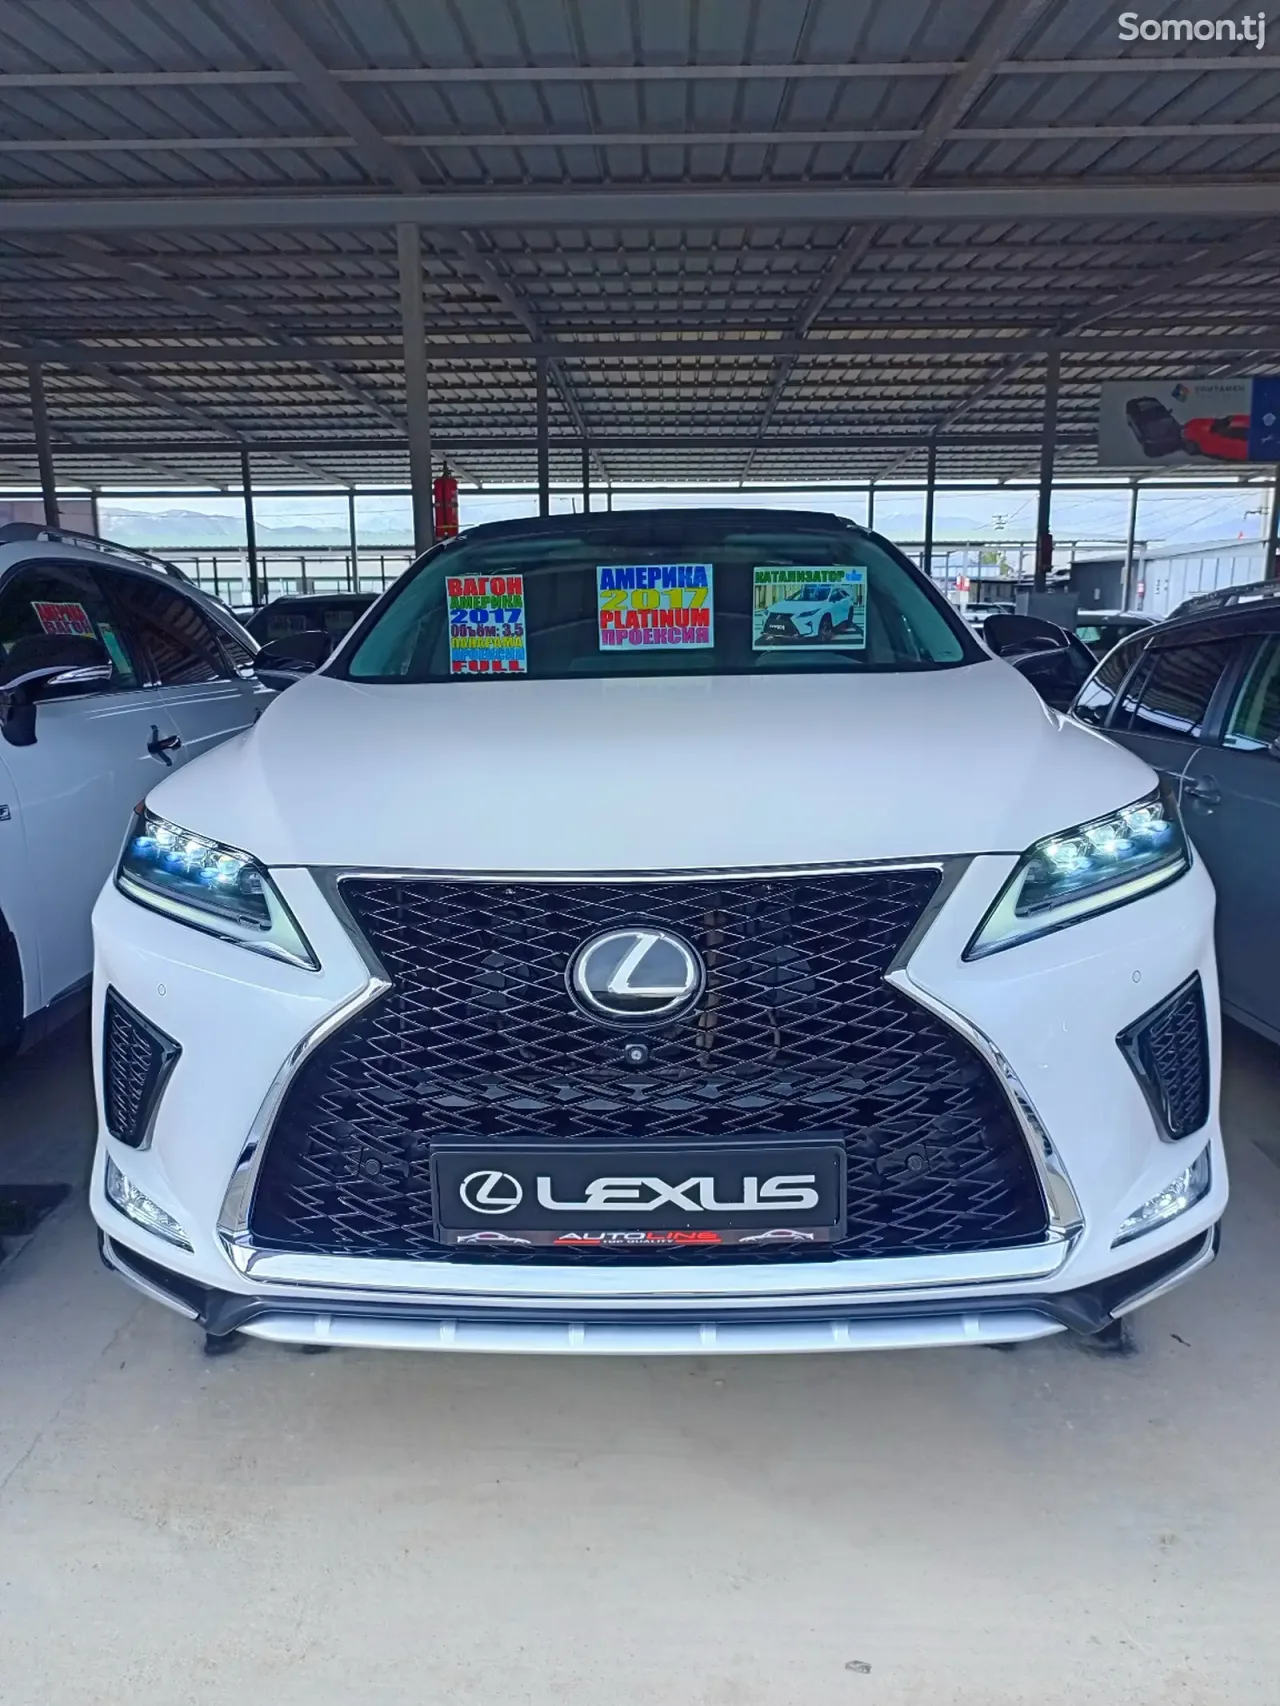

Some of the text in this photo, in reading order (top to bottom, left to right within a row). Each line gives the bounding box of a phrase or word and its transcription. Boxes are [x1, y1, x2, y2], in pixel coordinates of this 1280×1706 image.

[599, 566, 708, 590] АМЕРИКА
[754, 571, 845, 583] КАТАЛИЗАТОР
[447, 577, 523, 596] ВАГОН
[450, 595, 523, 609] АМЕРИКА
[600, 587, 709, 610] 2017
[450, 608, 522, 624] 2017
[600, 608, 710, 629] PLATINUM
[502, 623, 523, 637] 3.5
[601, 627, 710, 645] ПРОЕКСИЯ
[451, 660, 525, 672] FULL
[536, 1174, 819, 1211] LEXUS
[558, 1231, 718, 1241] AUTOLINE
